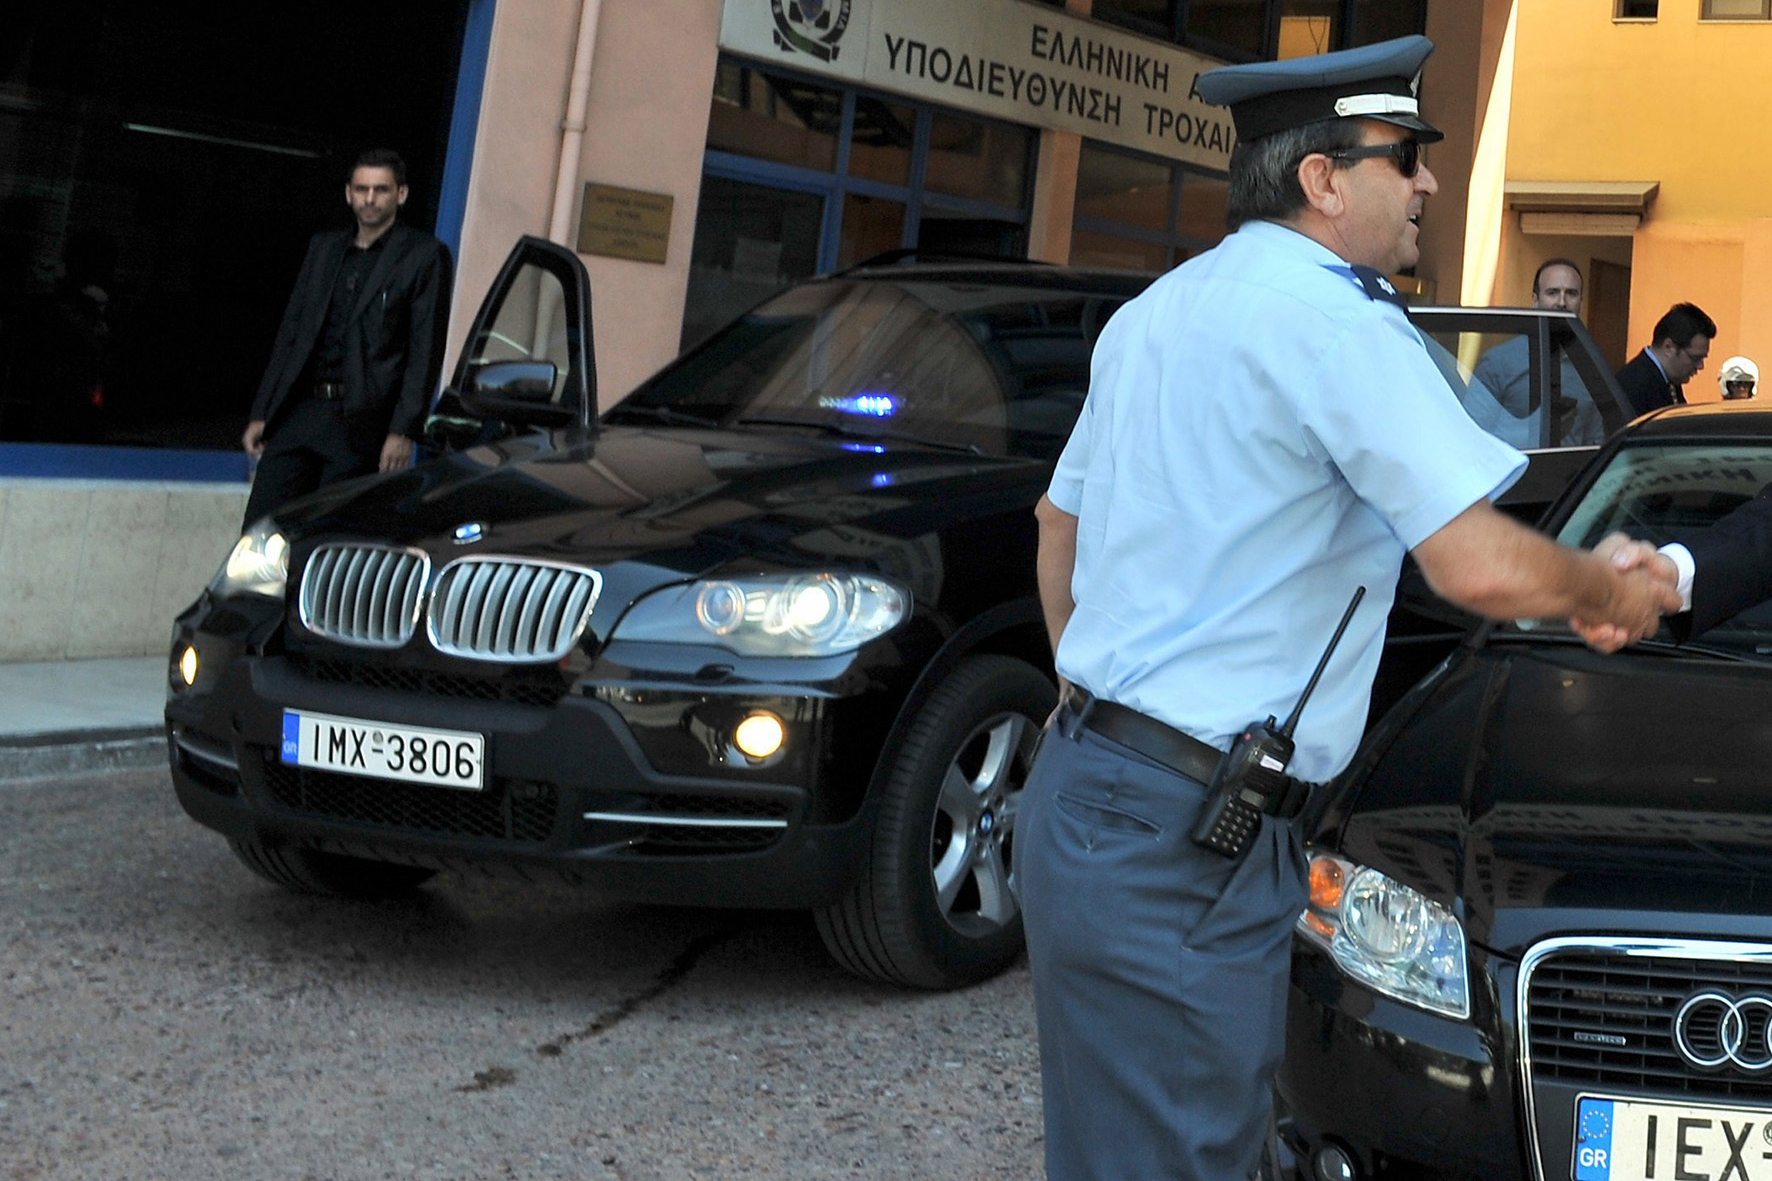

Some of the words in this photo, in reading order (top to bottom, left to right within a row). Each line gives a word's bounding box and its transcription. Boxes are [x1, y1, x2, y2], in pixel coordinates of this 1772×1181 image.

[884, 33, 1122, 127] ΥΠΟΔΙΕΥΘΥΝΣΗ
[1031, 24, 1169, 94] ΕΛΛΗΝΙΚΗ
[1579, 1147, 1608, 1169] GR
